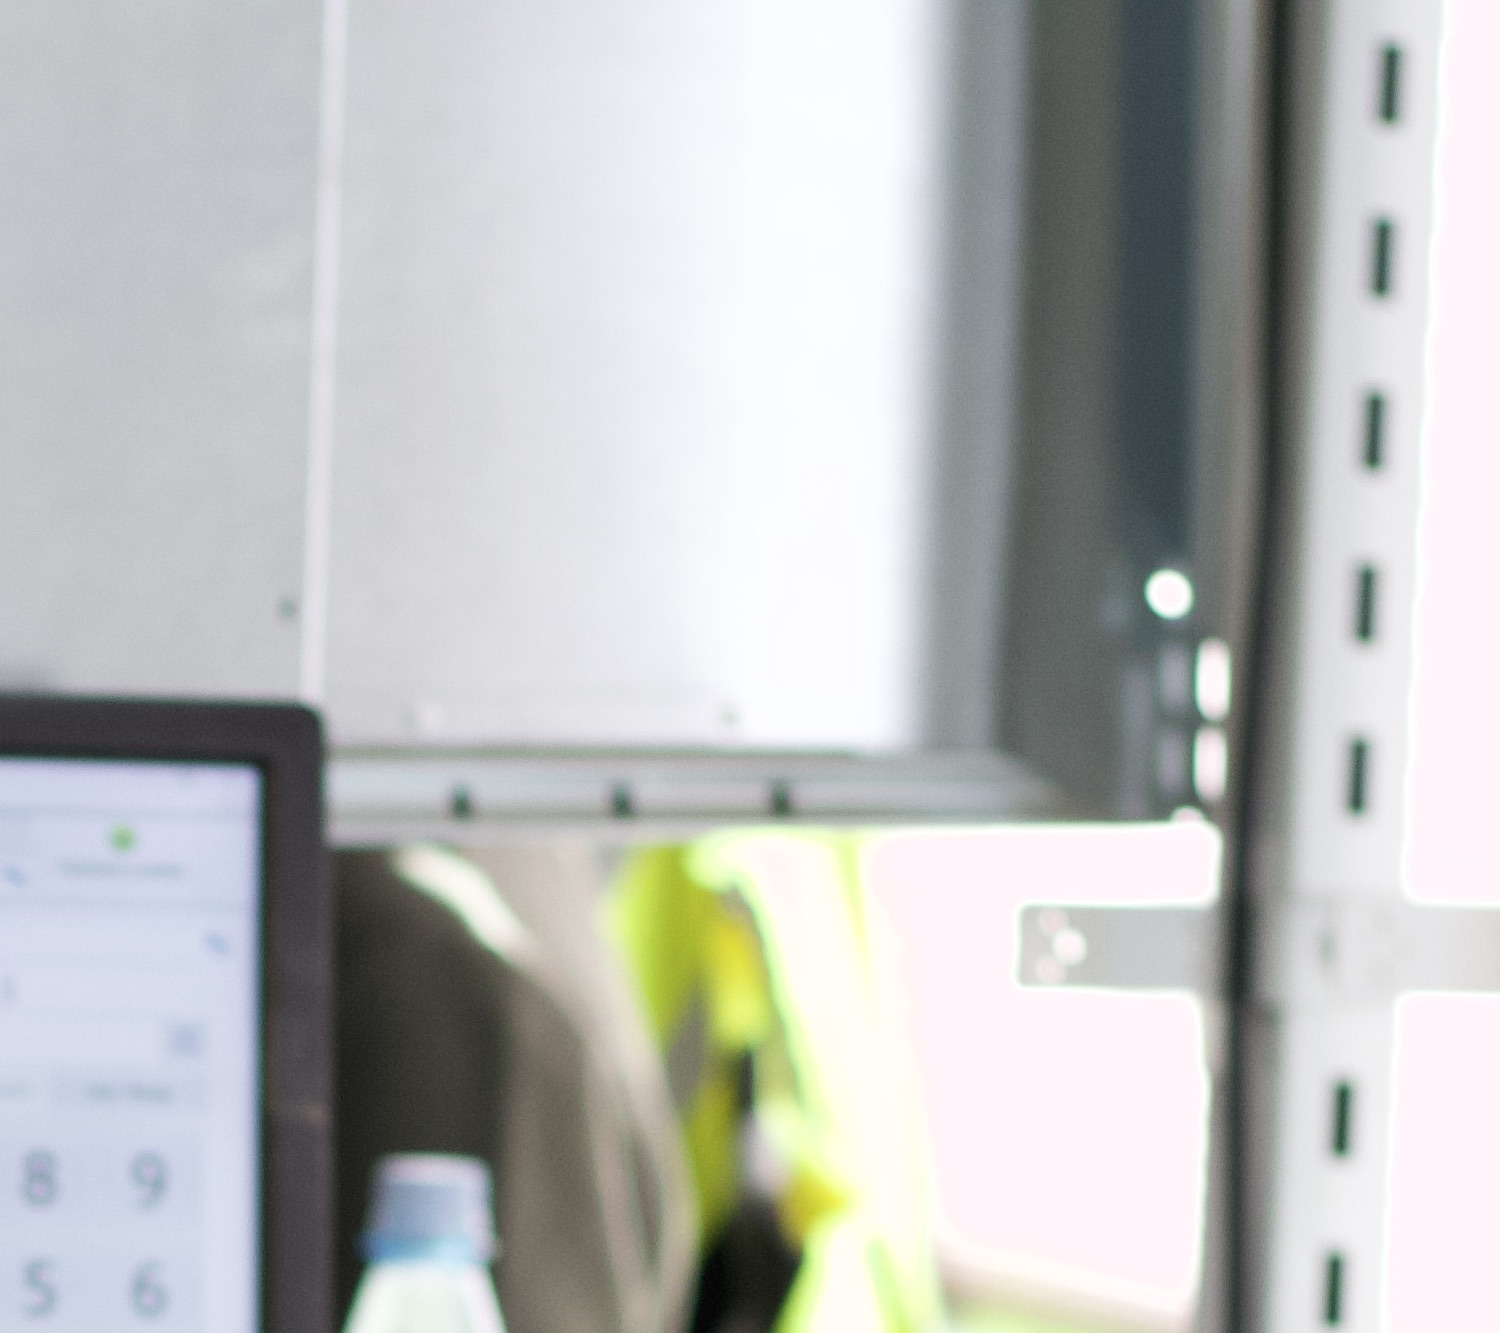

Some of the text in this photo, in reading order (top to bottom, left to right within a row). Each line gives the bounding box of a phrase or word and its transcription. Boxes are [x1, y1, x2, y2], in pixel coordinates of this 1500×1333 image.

[19, 1147, 59, 1207] 8
[129, 1150, 168, 1209] 9
[22, 1257, 58, 1319] 5
[130, 1258, 170, 1320] 6
